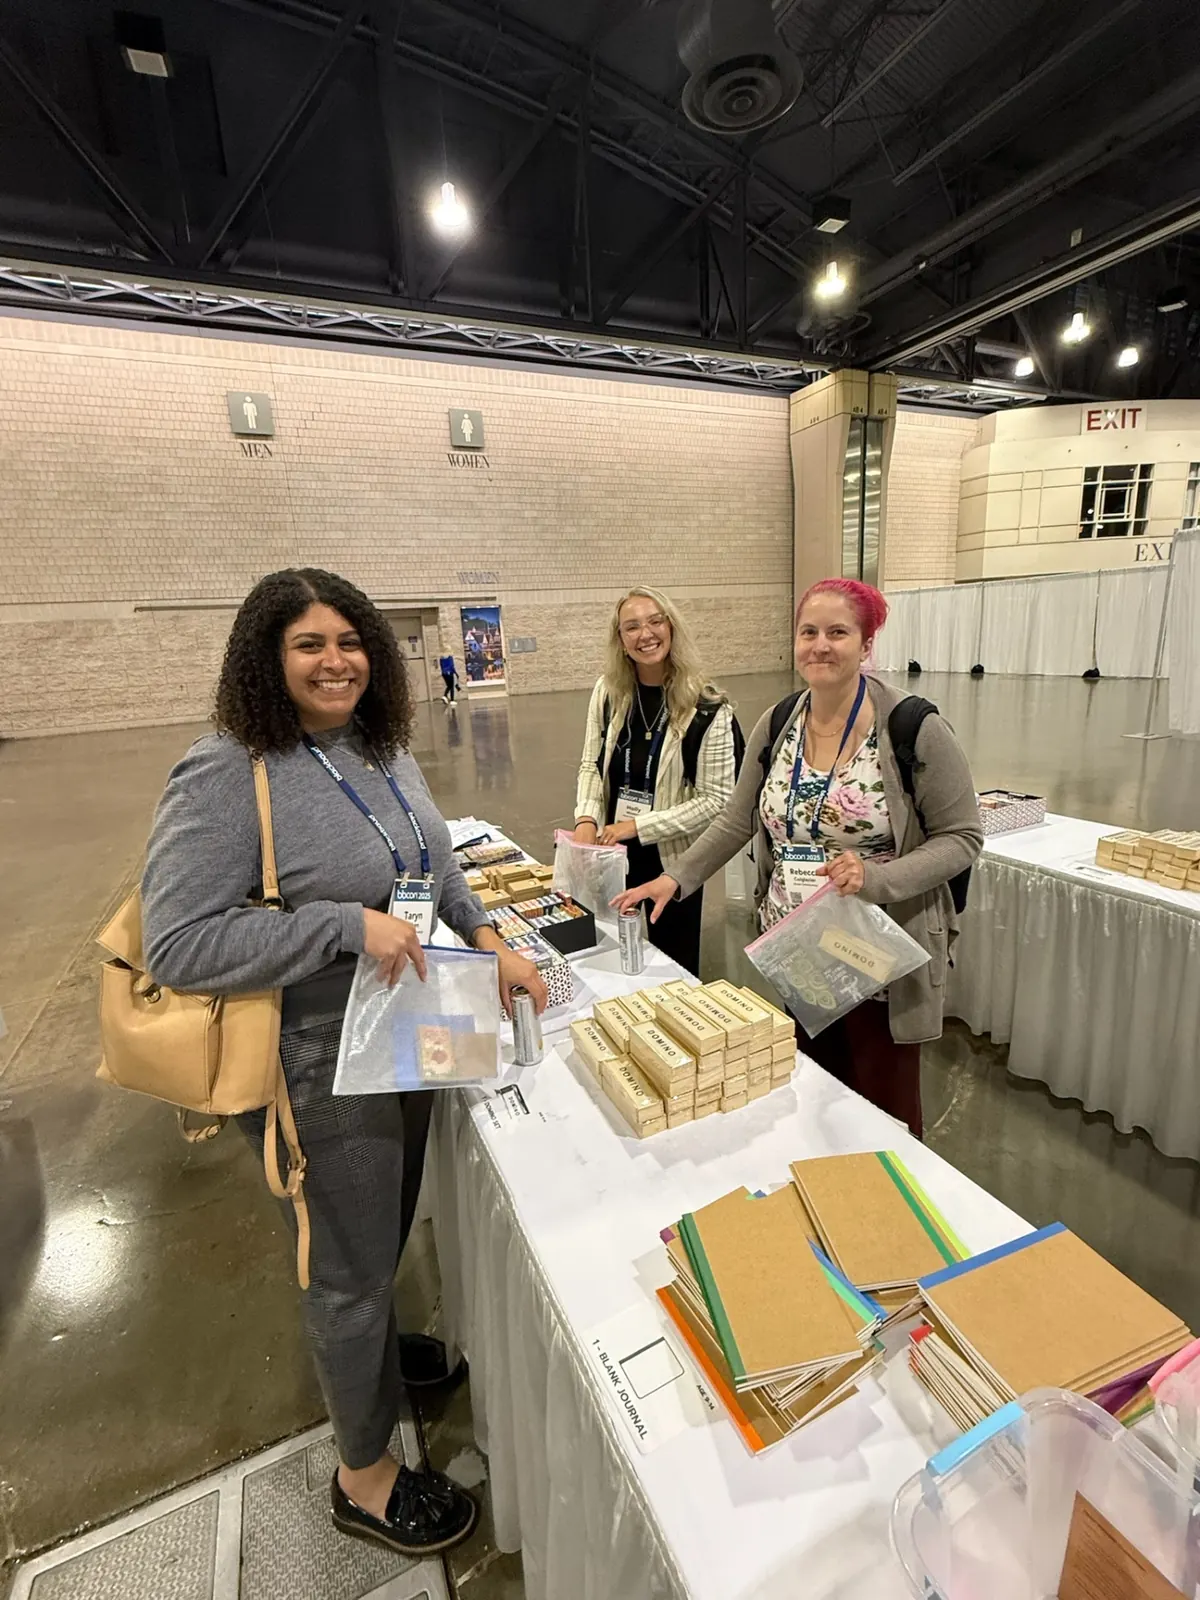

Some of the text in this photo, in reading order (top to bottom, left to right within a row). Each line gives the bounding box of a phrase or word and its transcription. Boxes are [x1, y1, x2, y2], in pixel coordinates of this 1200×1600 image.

[1087, 407, 1142, 431] EXIT
[240, 442, 274, 458] MEN
[446, 453, 490, 469] WOMEN
[1134, 542, 1172, 562] EXI
[456, 571, 500, 584] WOMEN
[310, 746, 343, 782] blackbaud
[368, 814, 396, 851] blackbaud
[408, 812, 427, 850] blackbaud
[789, 868, 816, 876] Rebecc
[397, 889, 431, 900] bbcon 2025
[404, 911, 423, 922] Taryn
[834, 941, 875, 968] DOMINO
[632, 1000, 652, 1019] OMINO
[699, 999, 732, 1024] DOMINO
[720, 989, 753, 1012] DOMINO
[673, 1006, 705, 1031] DOMINO
[584, 1026, 606, 1051] DOMINO
[647, 1029, 676, 1057] DOMINO
[620, 1066, 644, 1097] DOMINO
[599, 1352, 622, 1387] BLANK
[617, 1388, 648, 1440] JOURNAL
[696, 1384, 706, 1397] AGE
